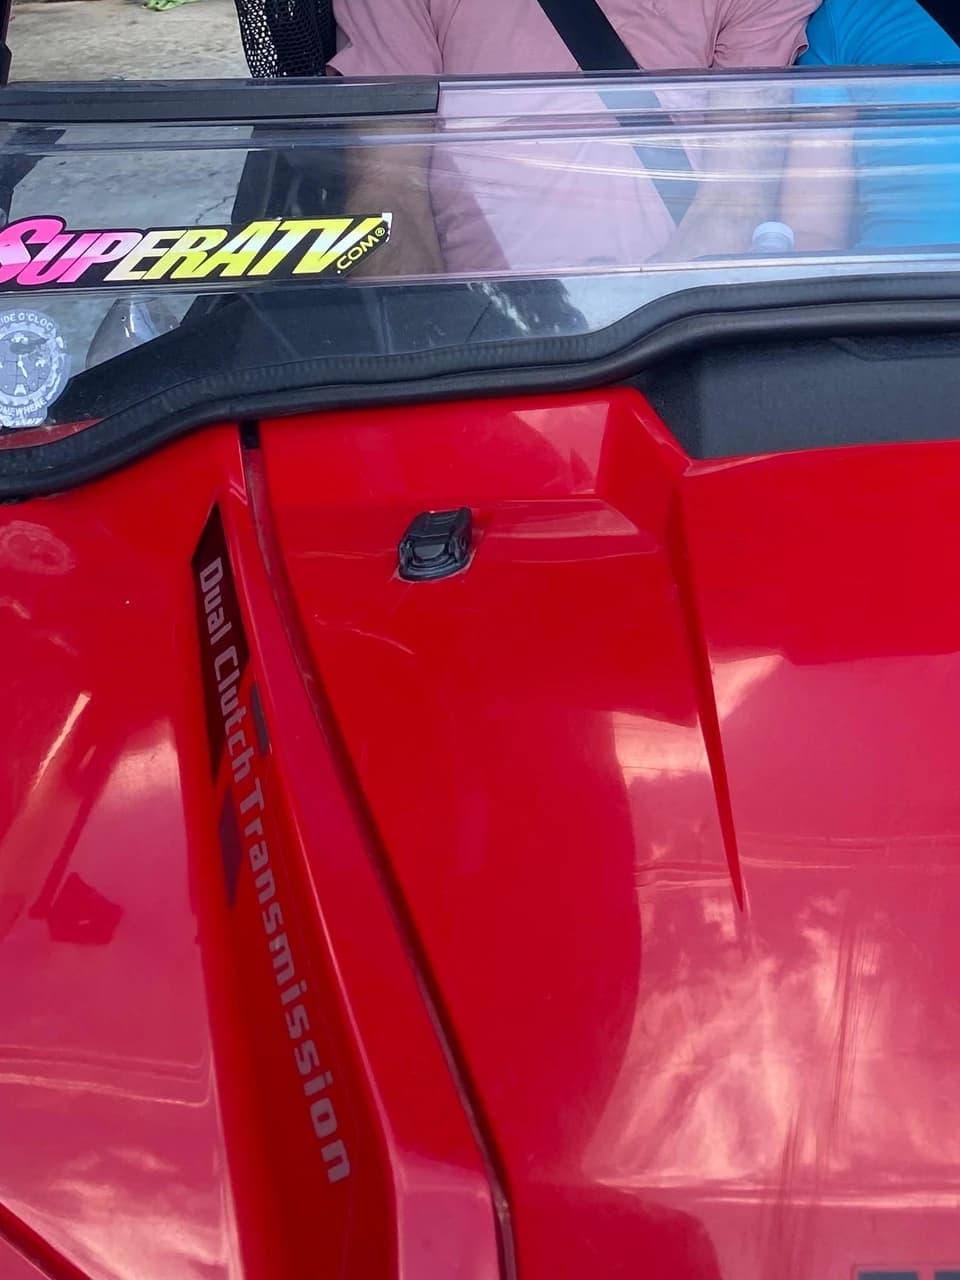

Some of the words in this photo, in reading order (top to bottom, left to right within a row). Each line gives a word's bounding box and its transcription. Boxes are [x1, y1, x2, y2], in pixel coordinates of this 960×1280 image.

[0, 217, 384, 286] SUPERATV
[200, 557, 232, 646] Dual
[214, 645, 255, 783] Clutch
[239, 776, 351, 1183] Transmission
